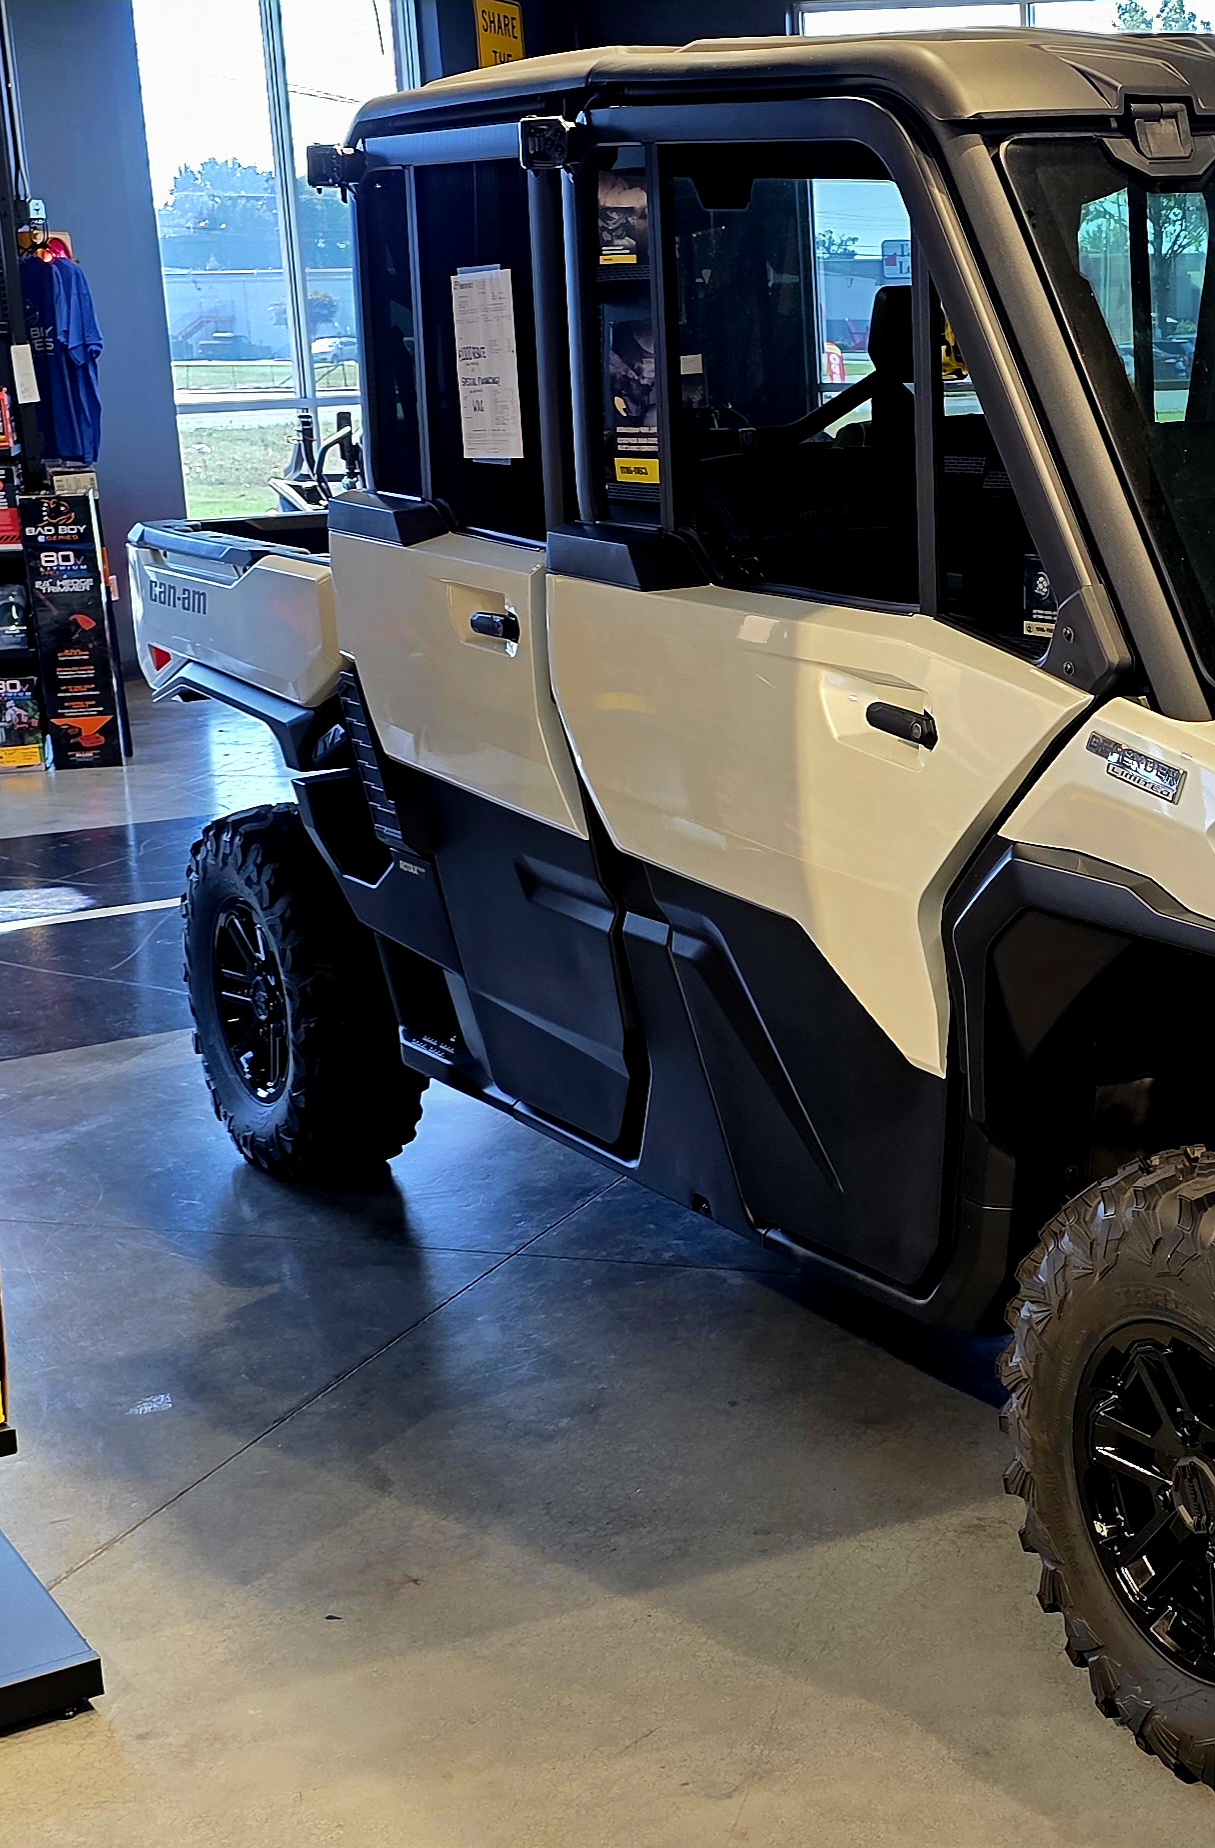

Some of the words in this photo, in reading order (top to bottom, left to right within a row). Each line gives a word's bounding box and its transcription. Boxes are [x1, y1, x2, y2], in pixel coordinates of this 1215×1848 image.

[481, 9, 518, 40] SHARE
[25, 526, 55, 536] BAD
[58, 524, 87, 534] BOY
[150, 579, 207, 615] can-am
[1110, 765, 1172, 797] LIMITED
